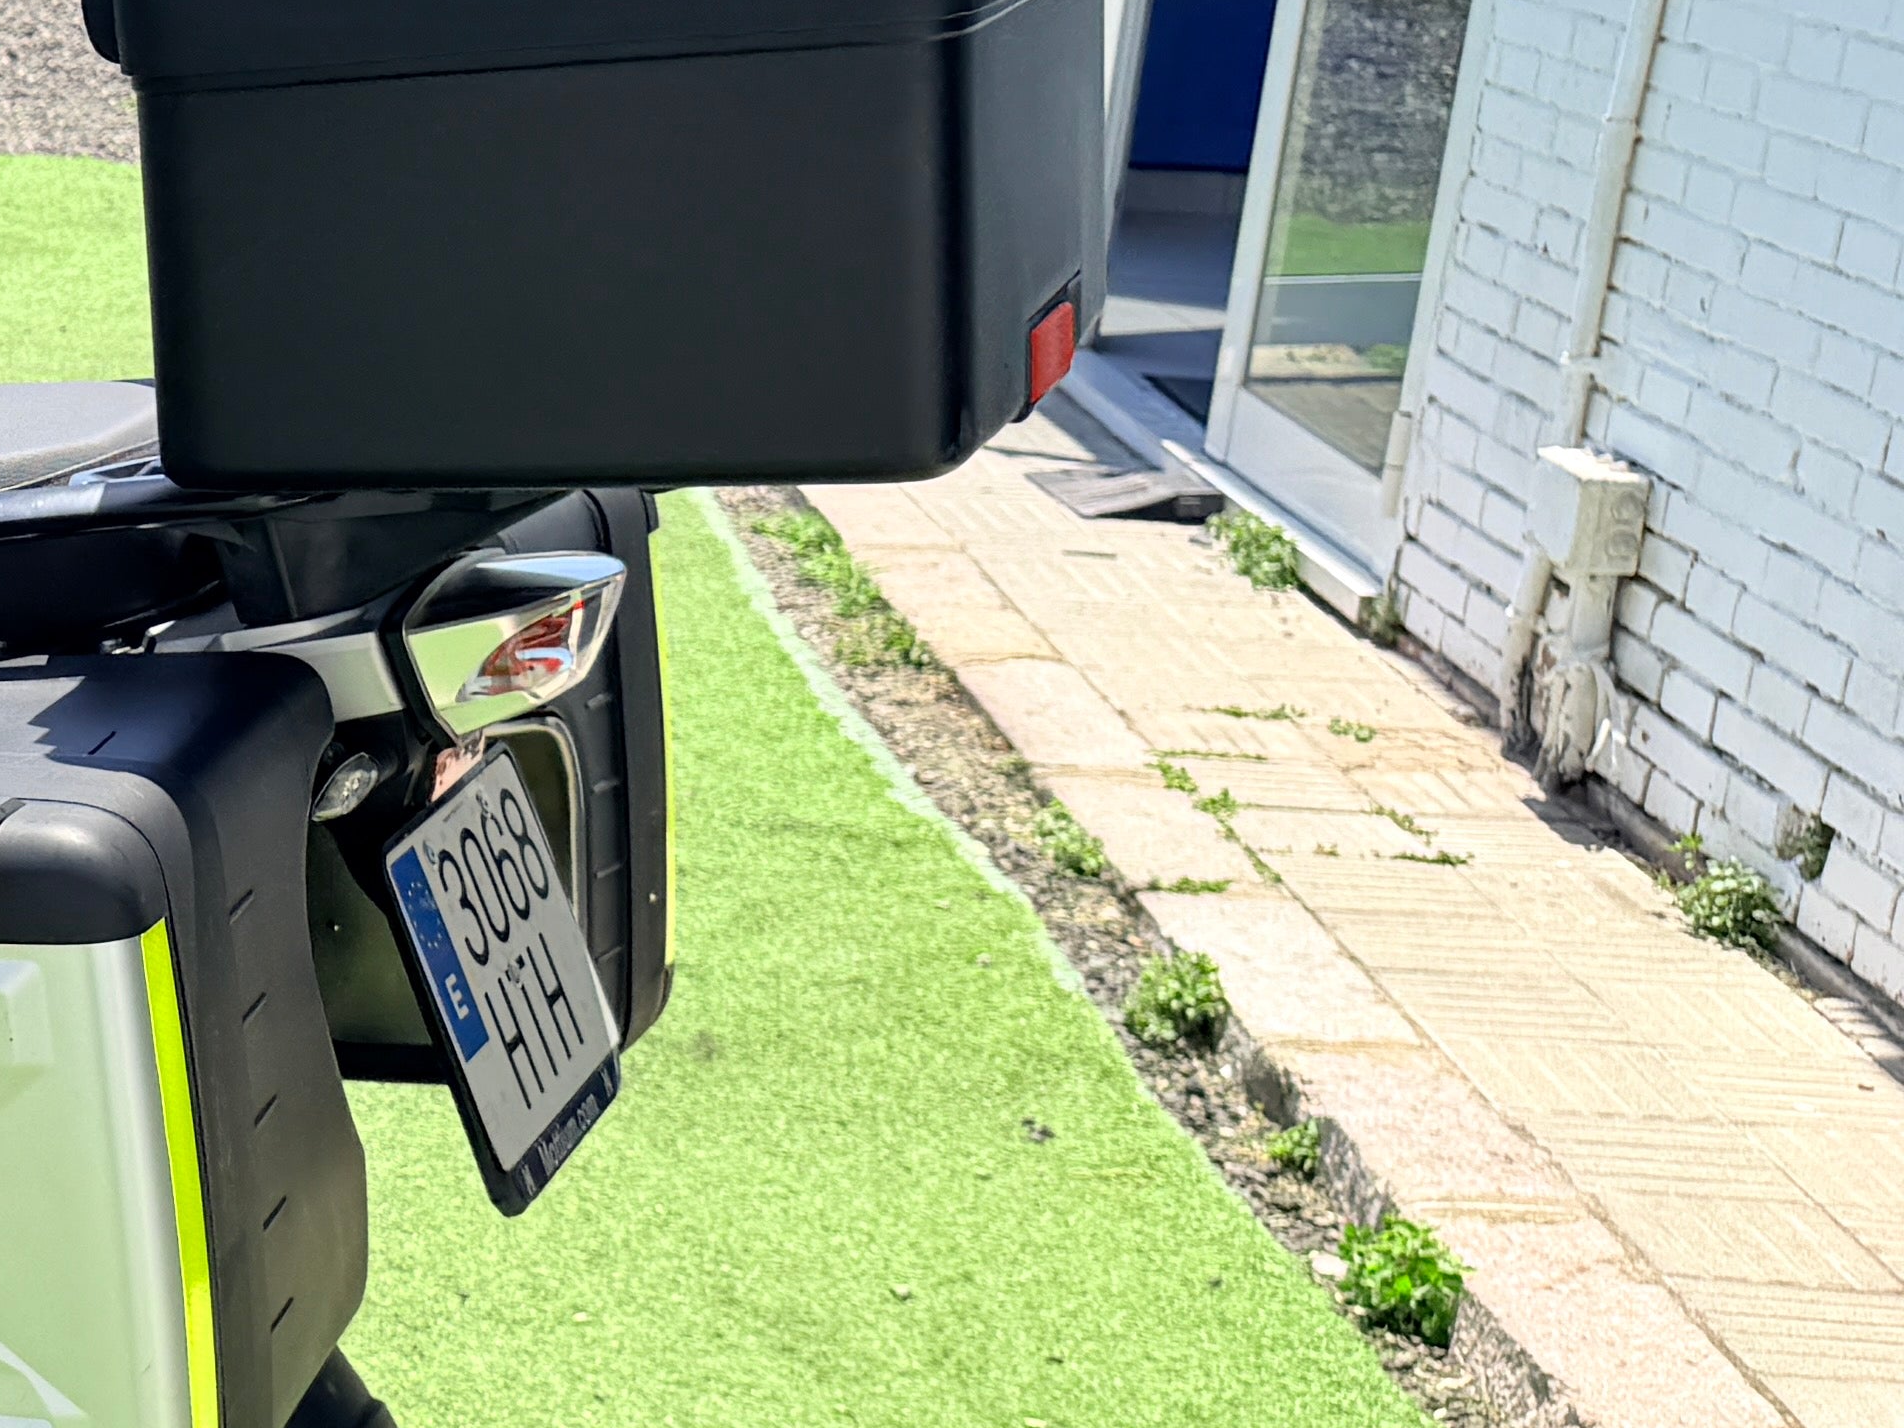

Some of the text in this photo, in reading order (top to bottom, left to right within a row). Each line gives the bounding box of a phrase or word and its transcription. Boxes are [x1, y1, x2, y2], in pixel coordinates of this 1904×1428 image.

[437, 787, 550, 967] 3068
[444, 972, 470, 1021] E
[484, 931, 585, 1111] HTH
